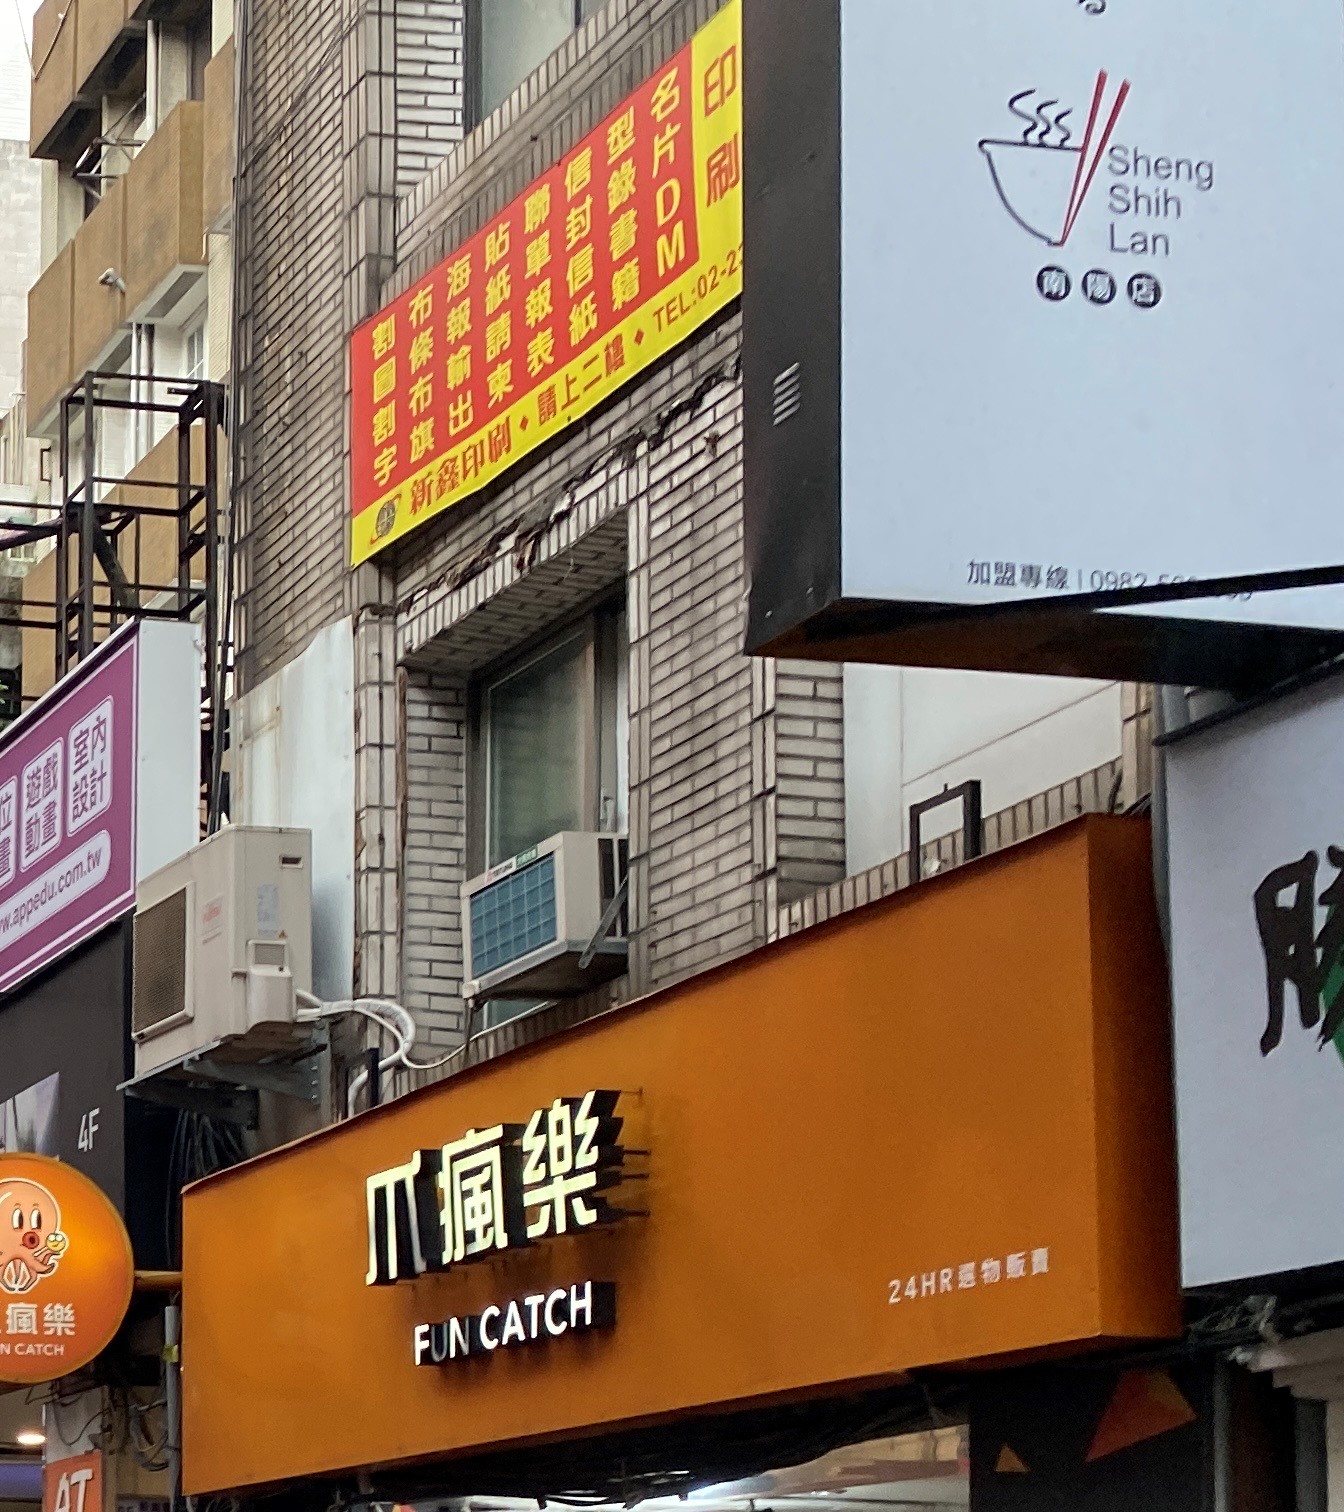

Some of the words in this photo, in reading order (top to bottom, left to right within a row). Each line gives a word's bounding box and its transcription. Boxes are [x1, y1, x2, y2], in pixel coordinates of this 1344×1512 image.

[650, 66, 687, 278] 名片DM
[705, 43, 740, 207] 印刷
[1107, 145, 1214, 191] Sheng
[564, 147, 598, 348] 信封信紙
[607, 107, 641, 313] 型錄書籍
[1108, 184, 1182, 219] Shih
[1109, 223, 1171, 257] Lan
[523, 182, 555, 378] 聯單報表
[372, 316, 397, 488] 割圖割字
[409, 283, 436, 464] 布條布旗
[446, 252, 476, 437] 海報輸出
[537, 336, 626, 425] 請上二樓
[72, 768, 108, 823] 設計
[73, 715, 108, 776] 室內
[77, 1107, 101, 1153] 4F
[365, 1090, 610, 1289] 爪瘋樂
[14, 1342, 65, 1358] CATCH
[413, 1313, 472, 1369] FUN
[479, 1280, 596, 1352] CATCH
